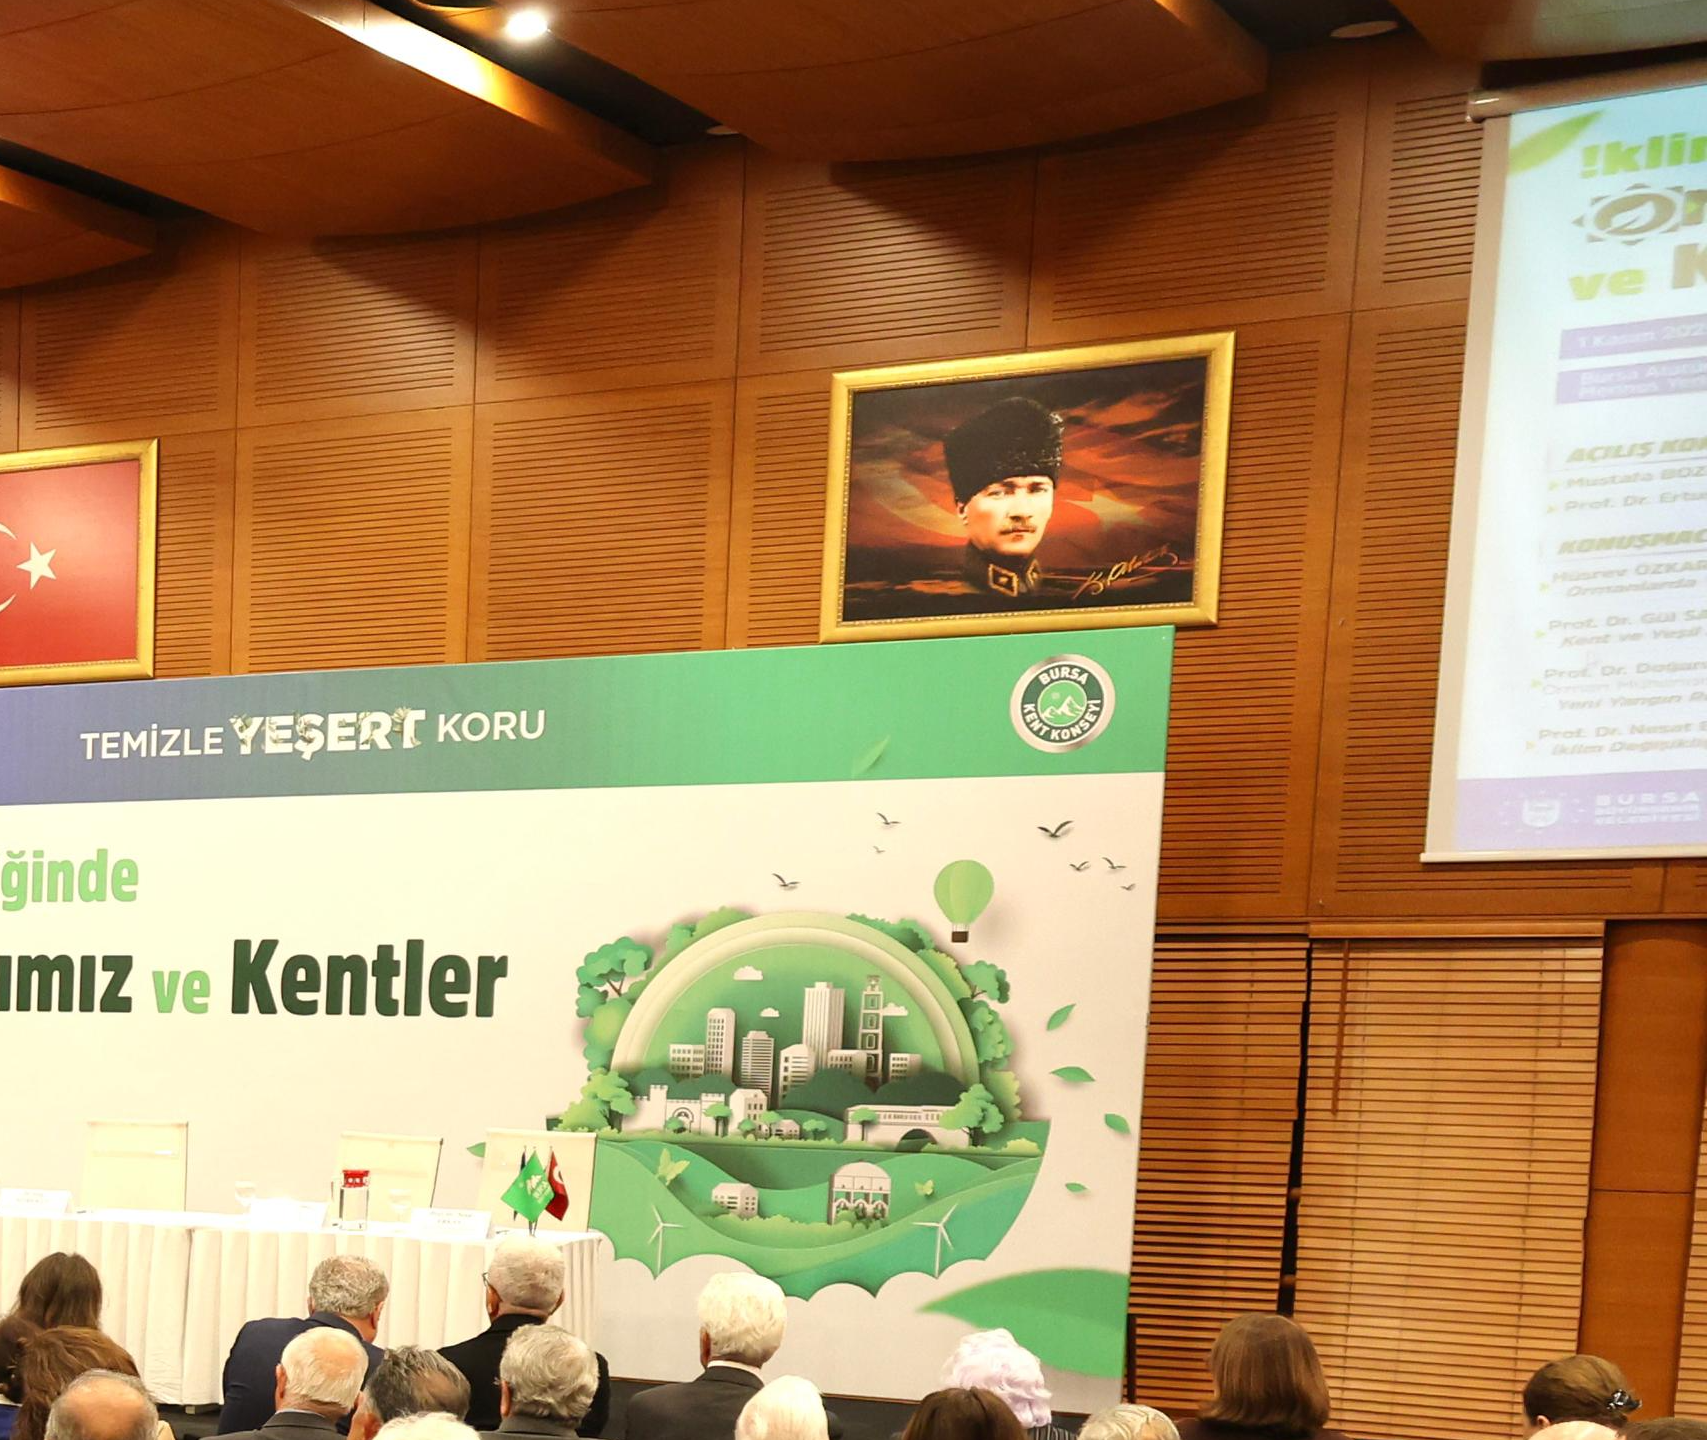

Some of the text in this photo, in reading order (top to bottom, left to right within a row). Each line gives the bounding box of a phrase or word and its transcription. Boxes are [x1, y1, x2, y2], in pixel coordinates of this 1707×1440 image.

[1569, 269, 1645, 300] ve
[1038, 666, 1089, 685] BURSA
[80, 707, 547, 760] TEMİZLE YEŞERT KORU
[1023, 703, 1050, 736] KENT
[153, 962, 212, 1016] ve
[230, 938, 509, 1019] Kentler
